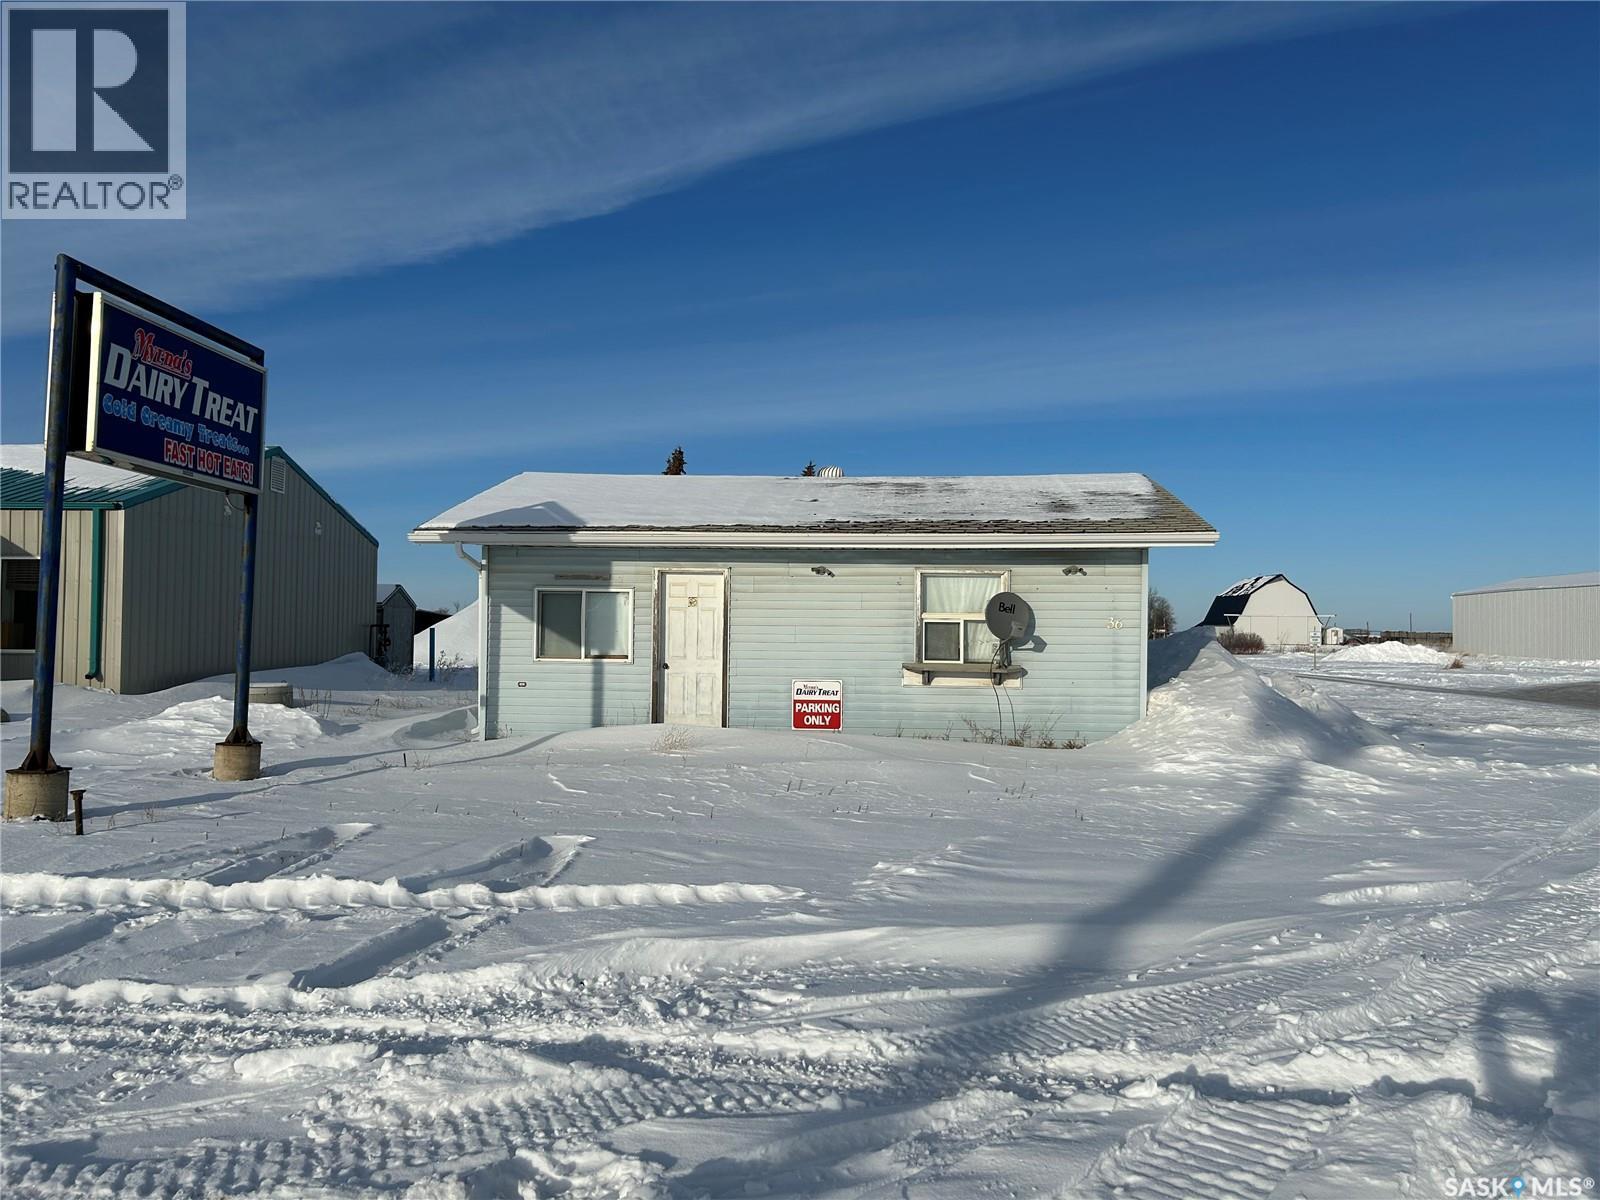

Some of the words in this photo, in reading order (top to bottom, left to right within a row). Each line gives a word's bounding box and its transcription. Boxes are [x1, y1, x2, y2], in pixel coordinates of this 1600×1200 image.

[131, 328, 193, 376] Myrna's
[104, 342, 190, 409] DAIRY
[191, 375, 259, 434] TREAT
[102, 393, 137, 422] Cold
[141, 405, 195, 442] Creamy
[163, 438, 195, 470] FAST
[197, 447, 222, 476] HOT
[223, 455, 254, 485] EATS!
[998, 602, 1016, 615] Bell
[1106, 617, 1123, 630] 36
[796, 688, 818, 696] DAIRY
[795, 703, 840, 713] PARKING
[804, 715, 832, 726] ONLY
